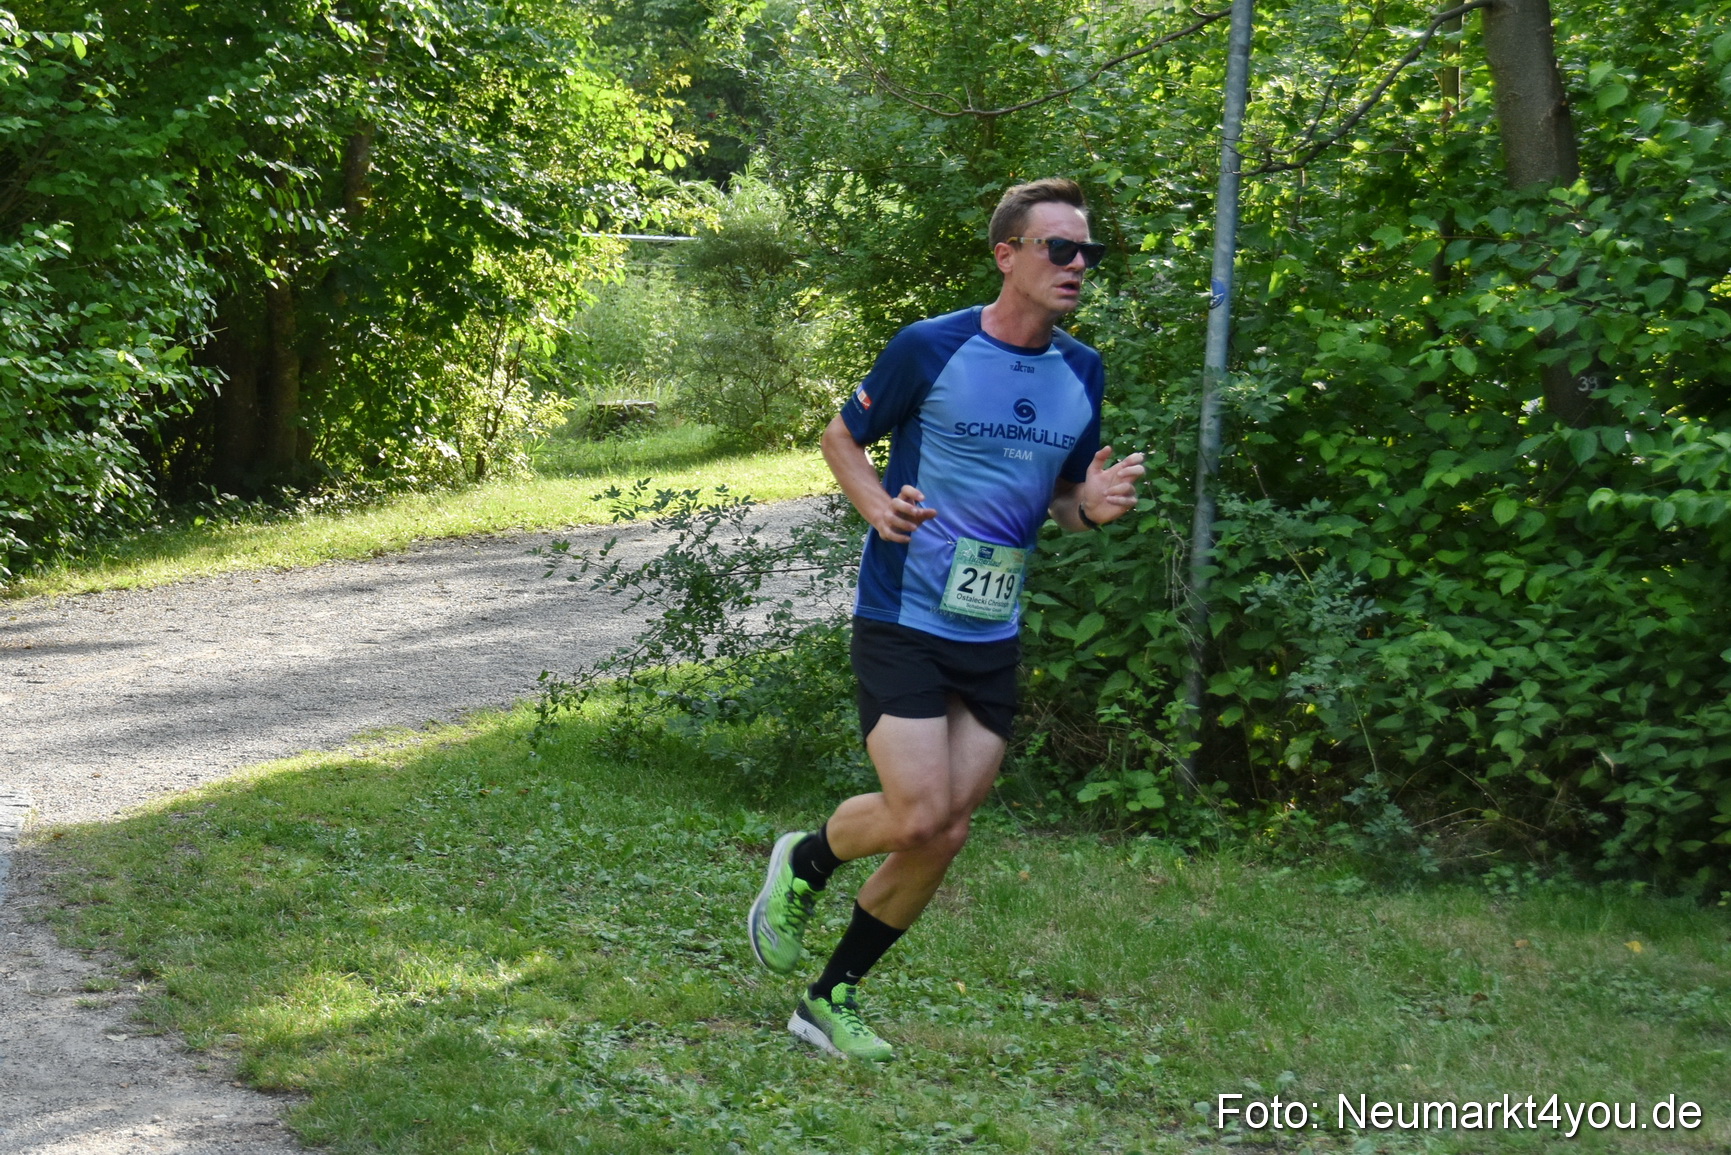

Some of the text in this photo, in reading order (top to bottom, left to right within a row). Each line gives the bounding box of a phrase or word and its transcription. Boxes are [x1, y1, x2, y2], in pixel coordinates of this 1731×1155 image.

[954, 422, 1076, 450] SCHABMÜLLER
[1003, 448, 1033, 461] TEAM
[957, 567, 1015, 600] 2119
